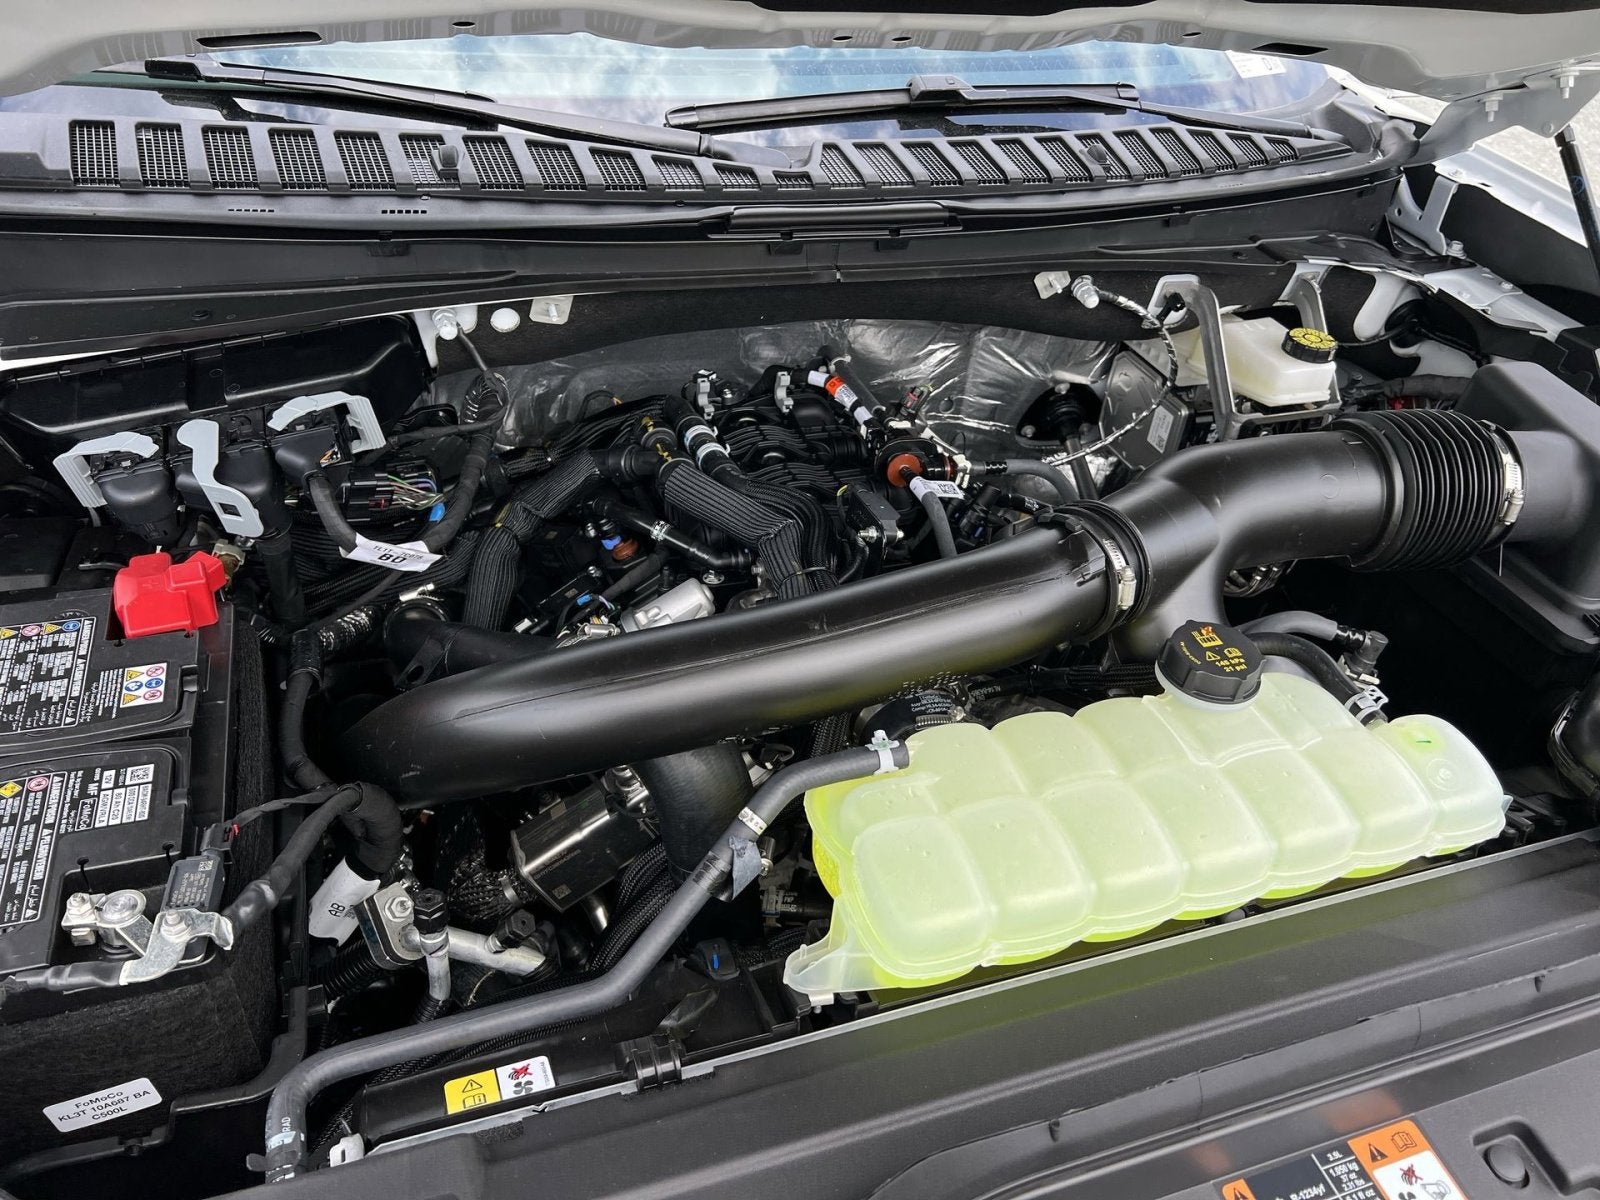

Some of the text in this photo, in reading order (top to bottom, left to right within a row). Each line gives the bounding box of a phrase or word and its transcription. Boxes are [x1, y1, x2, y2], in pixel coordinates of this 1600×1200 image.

[87, 783, 99, 796] MF
[79, 800, 93, 830] FoMoCo
[328, 903, 345, 917] AB
[75, 1091, 124, 1108] FoMoCo
[58, 1110, 87, 1122] KL3T
[92, 1106, 128, 1120] C500L
[282, 1117, 291, 1132] RAD
